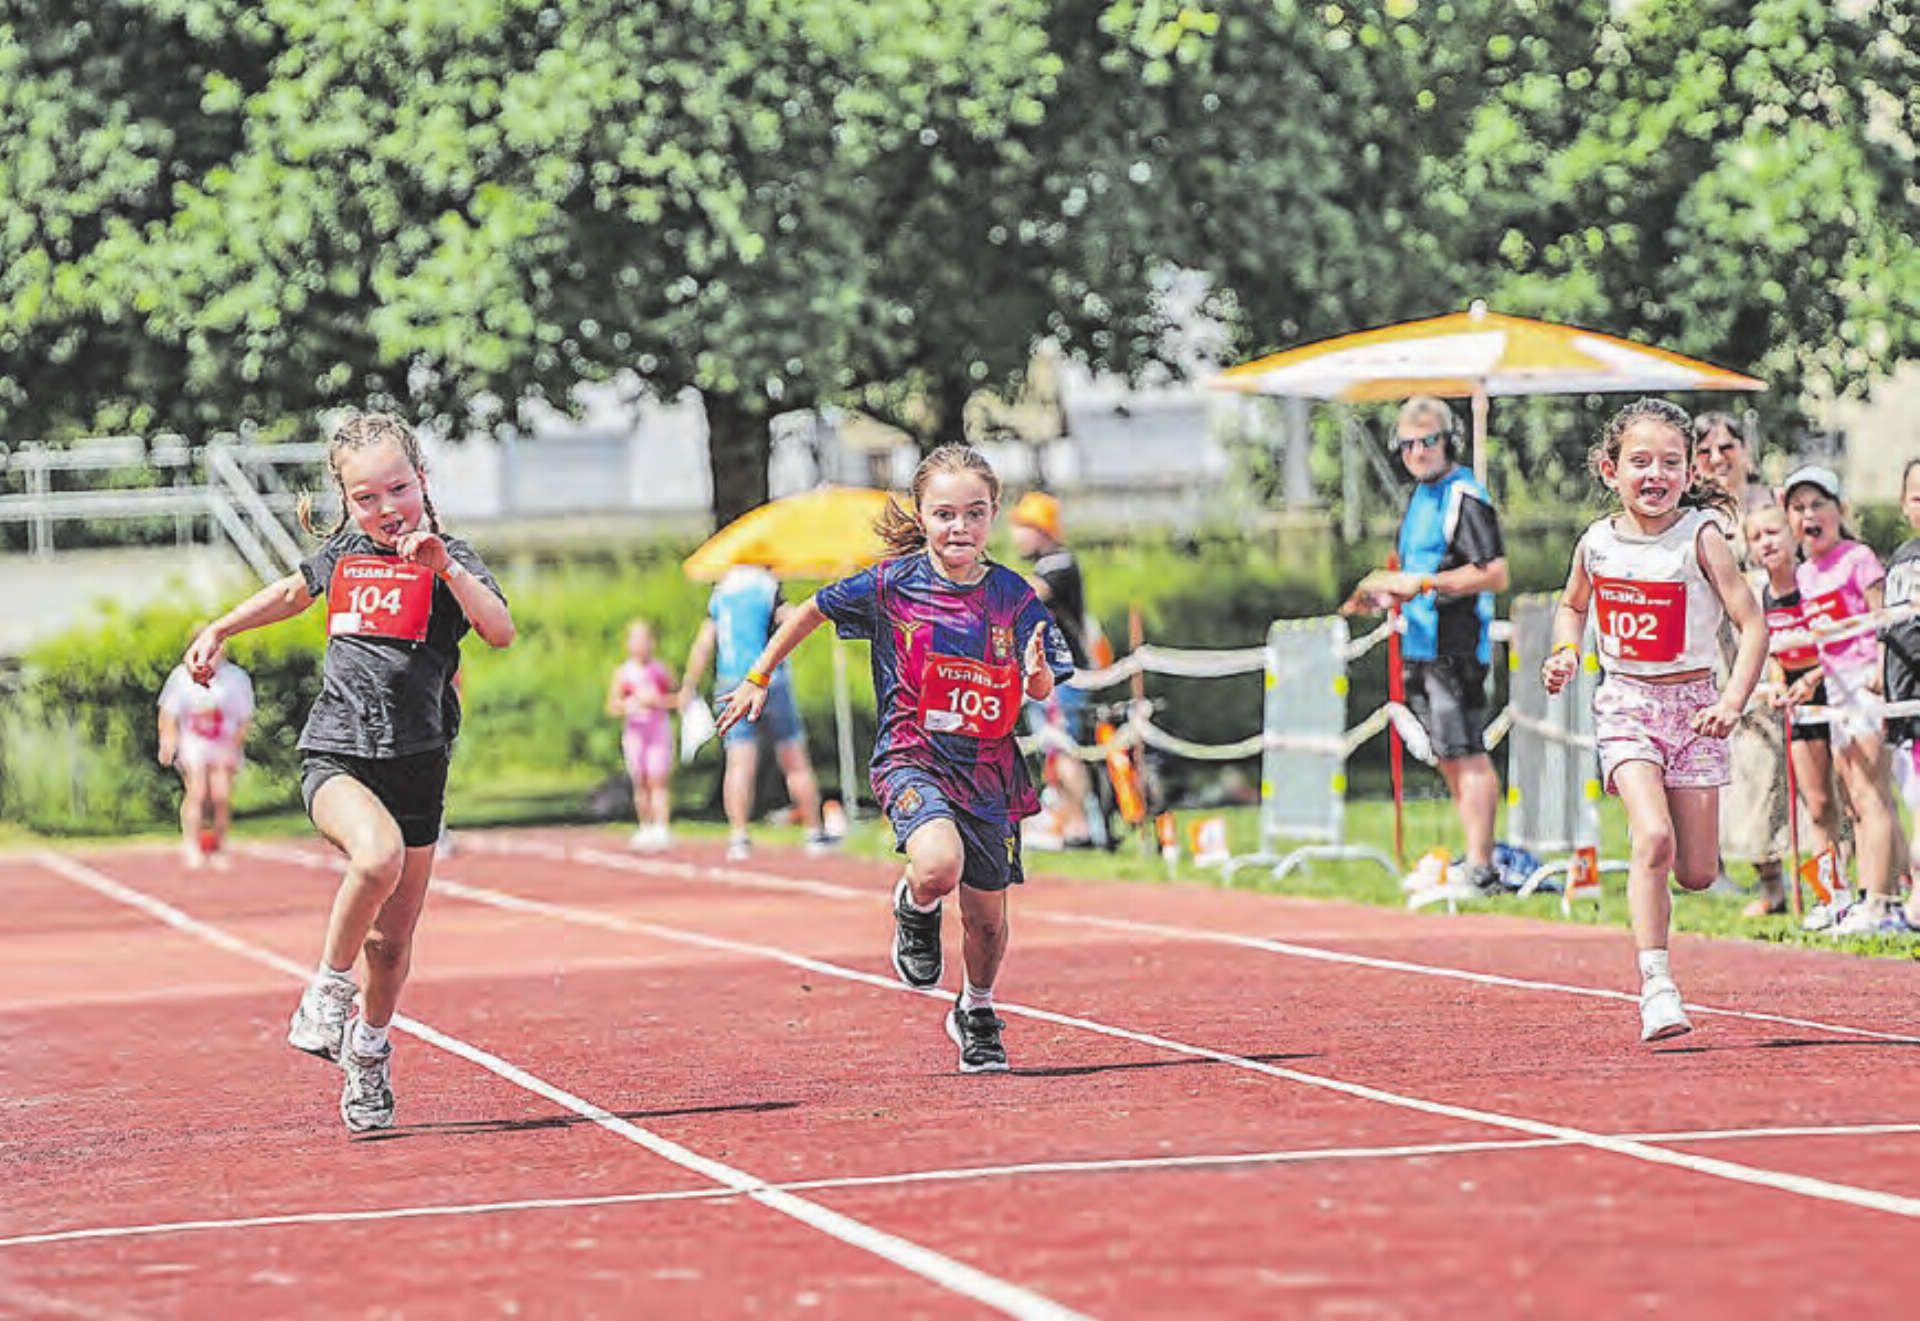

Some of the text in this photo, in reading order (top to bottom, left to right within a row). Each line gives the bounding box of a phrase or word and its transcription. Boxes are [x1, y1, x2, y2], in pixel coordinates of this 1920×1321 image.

[347, 586, 402, 616] 104
[1607, 609, 1658, 640] 102
[946, 687, 1001, 720] 103
